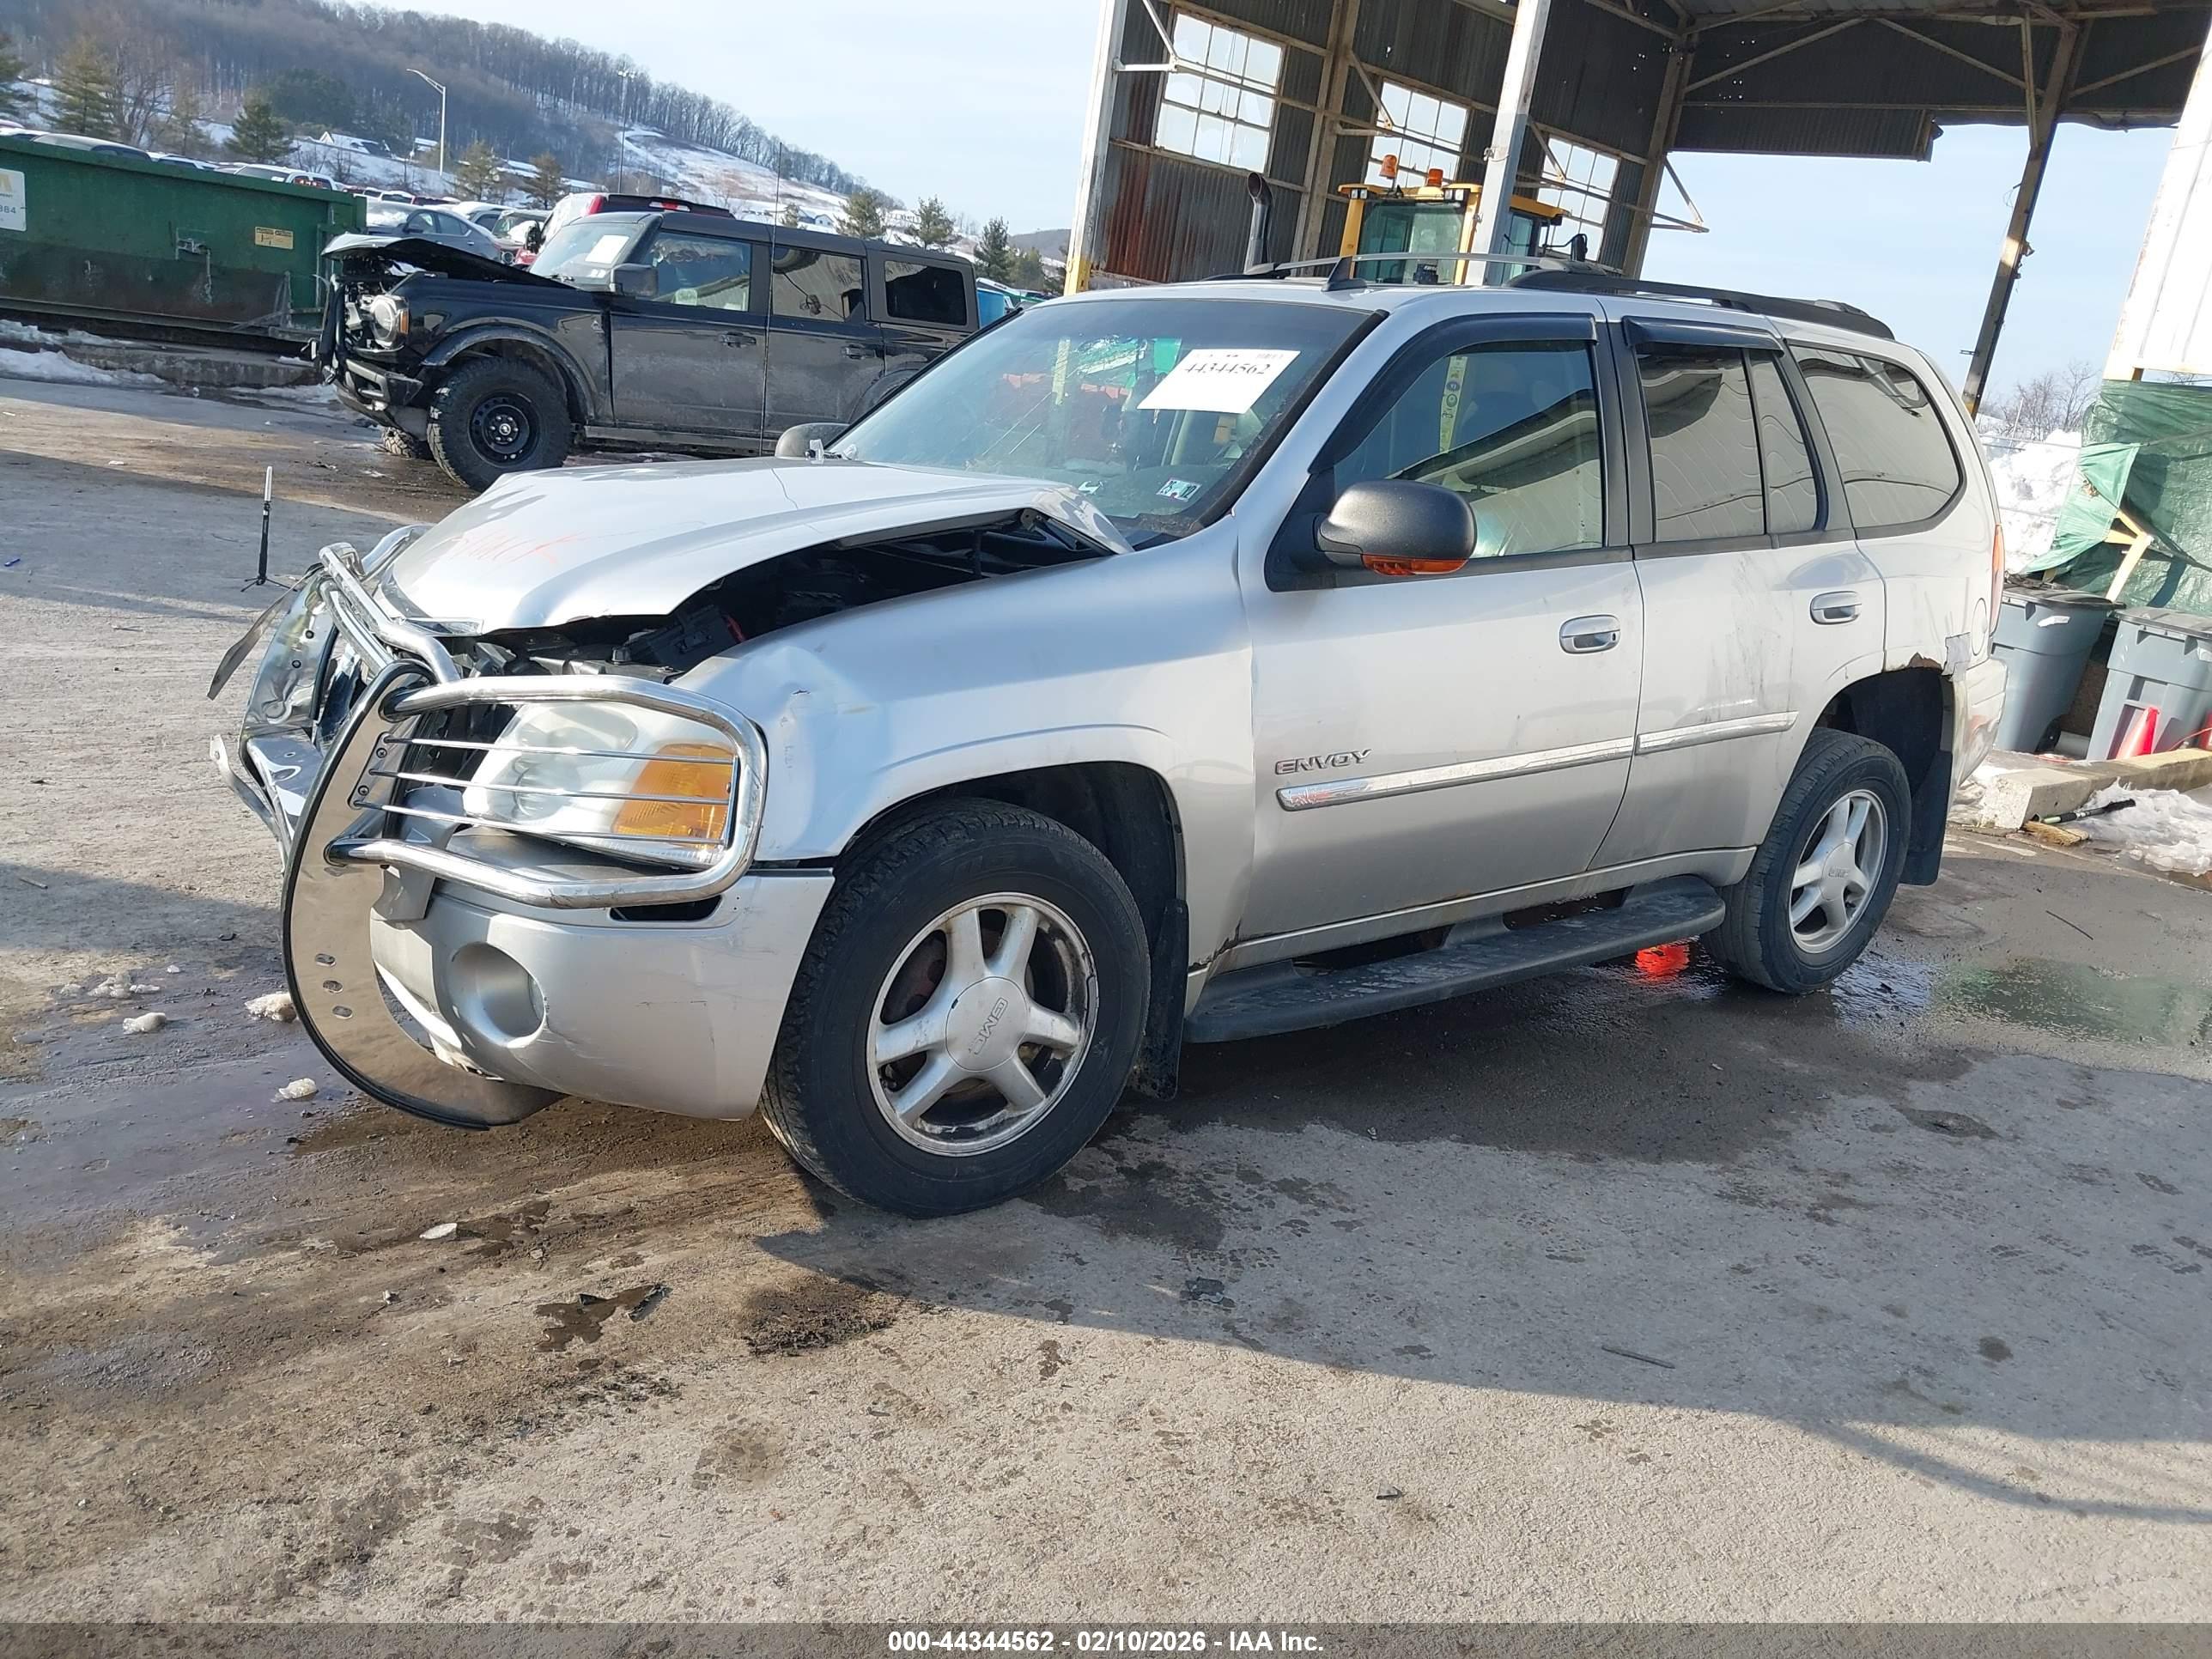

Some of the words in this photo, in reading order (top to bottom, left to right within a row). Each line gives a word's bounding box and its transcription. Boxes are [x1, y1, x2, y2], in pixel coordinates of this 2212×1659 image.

[1185, 362, 1271, 375] 44344562
[1274, 748, 1373, 775] ENVOY
[968, 997, 1009, 1056] GMC
